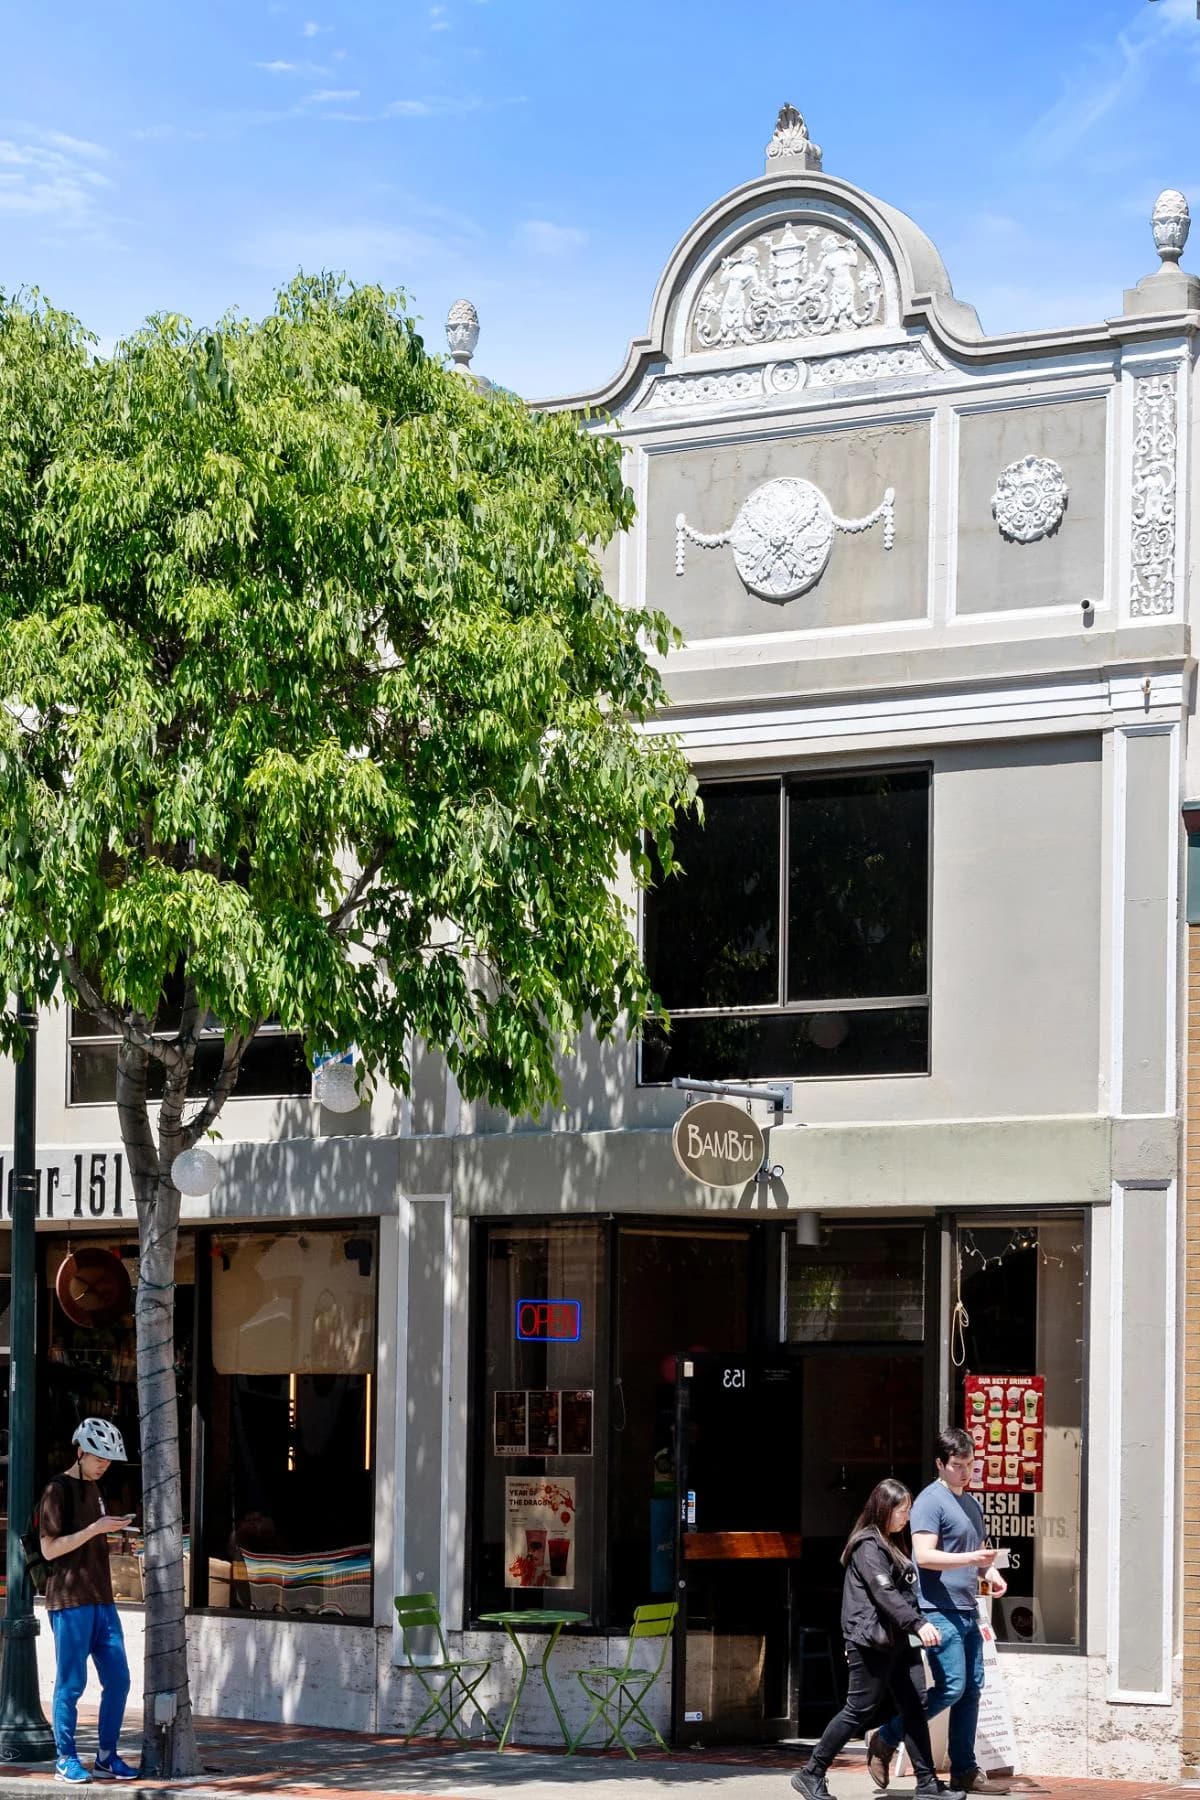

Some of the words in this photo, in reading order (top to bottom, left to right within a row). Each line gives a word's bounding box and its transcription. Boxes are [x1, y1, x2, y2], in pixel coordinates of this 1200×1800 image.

[73, 1153, 122, 1217] 151
[520, 1304, 577, 1337] OPEN
[967, 1492, 1020, 1514] RESH
